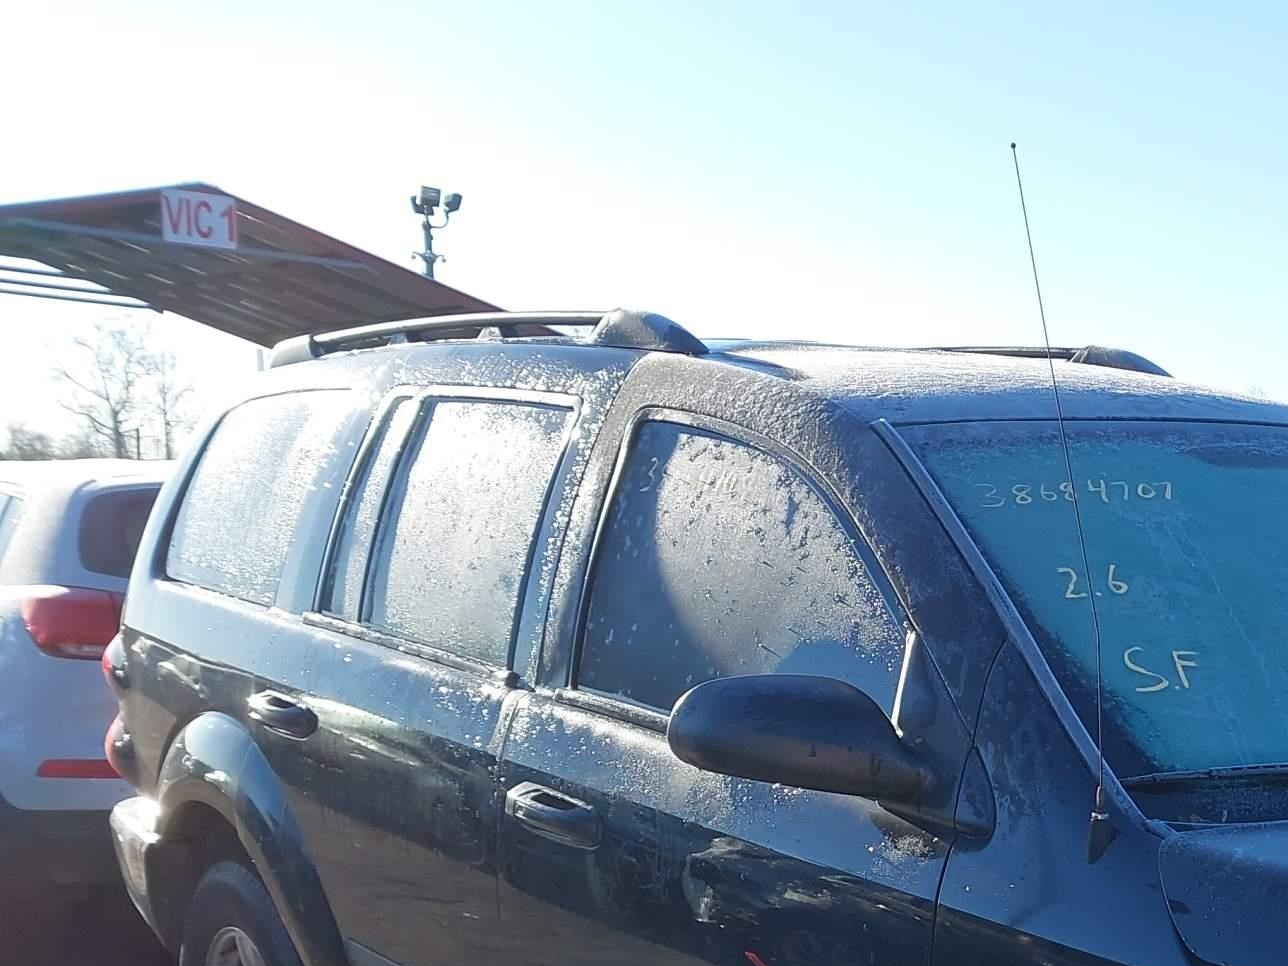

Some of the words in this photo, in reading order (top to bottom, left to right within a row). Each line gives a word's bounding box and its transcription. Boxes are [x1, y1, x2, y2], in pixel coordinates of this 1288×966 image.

[161, 193, 213, 239] VIC
[220, 204, 238, 243] 1
[974, 478, 1172, 508] 38684707
[1055, 563, 1129, 598] 2.6
